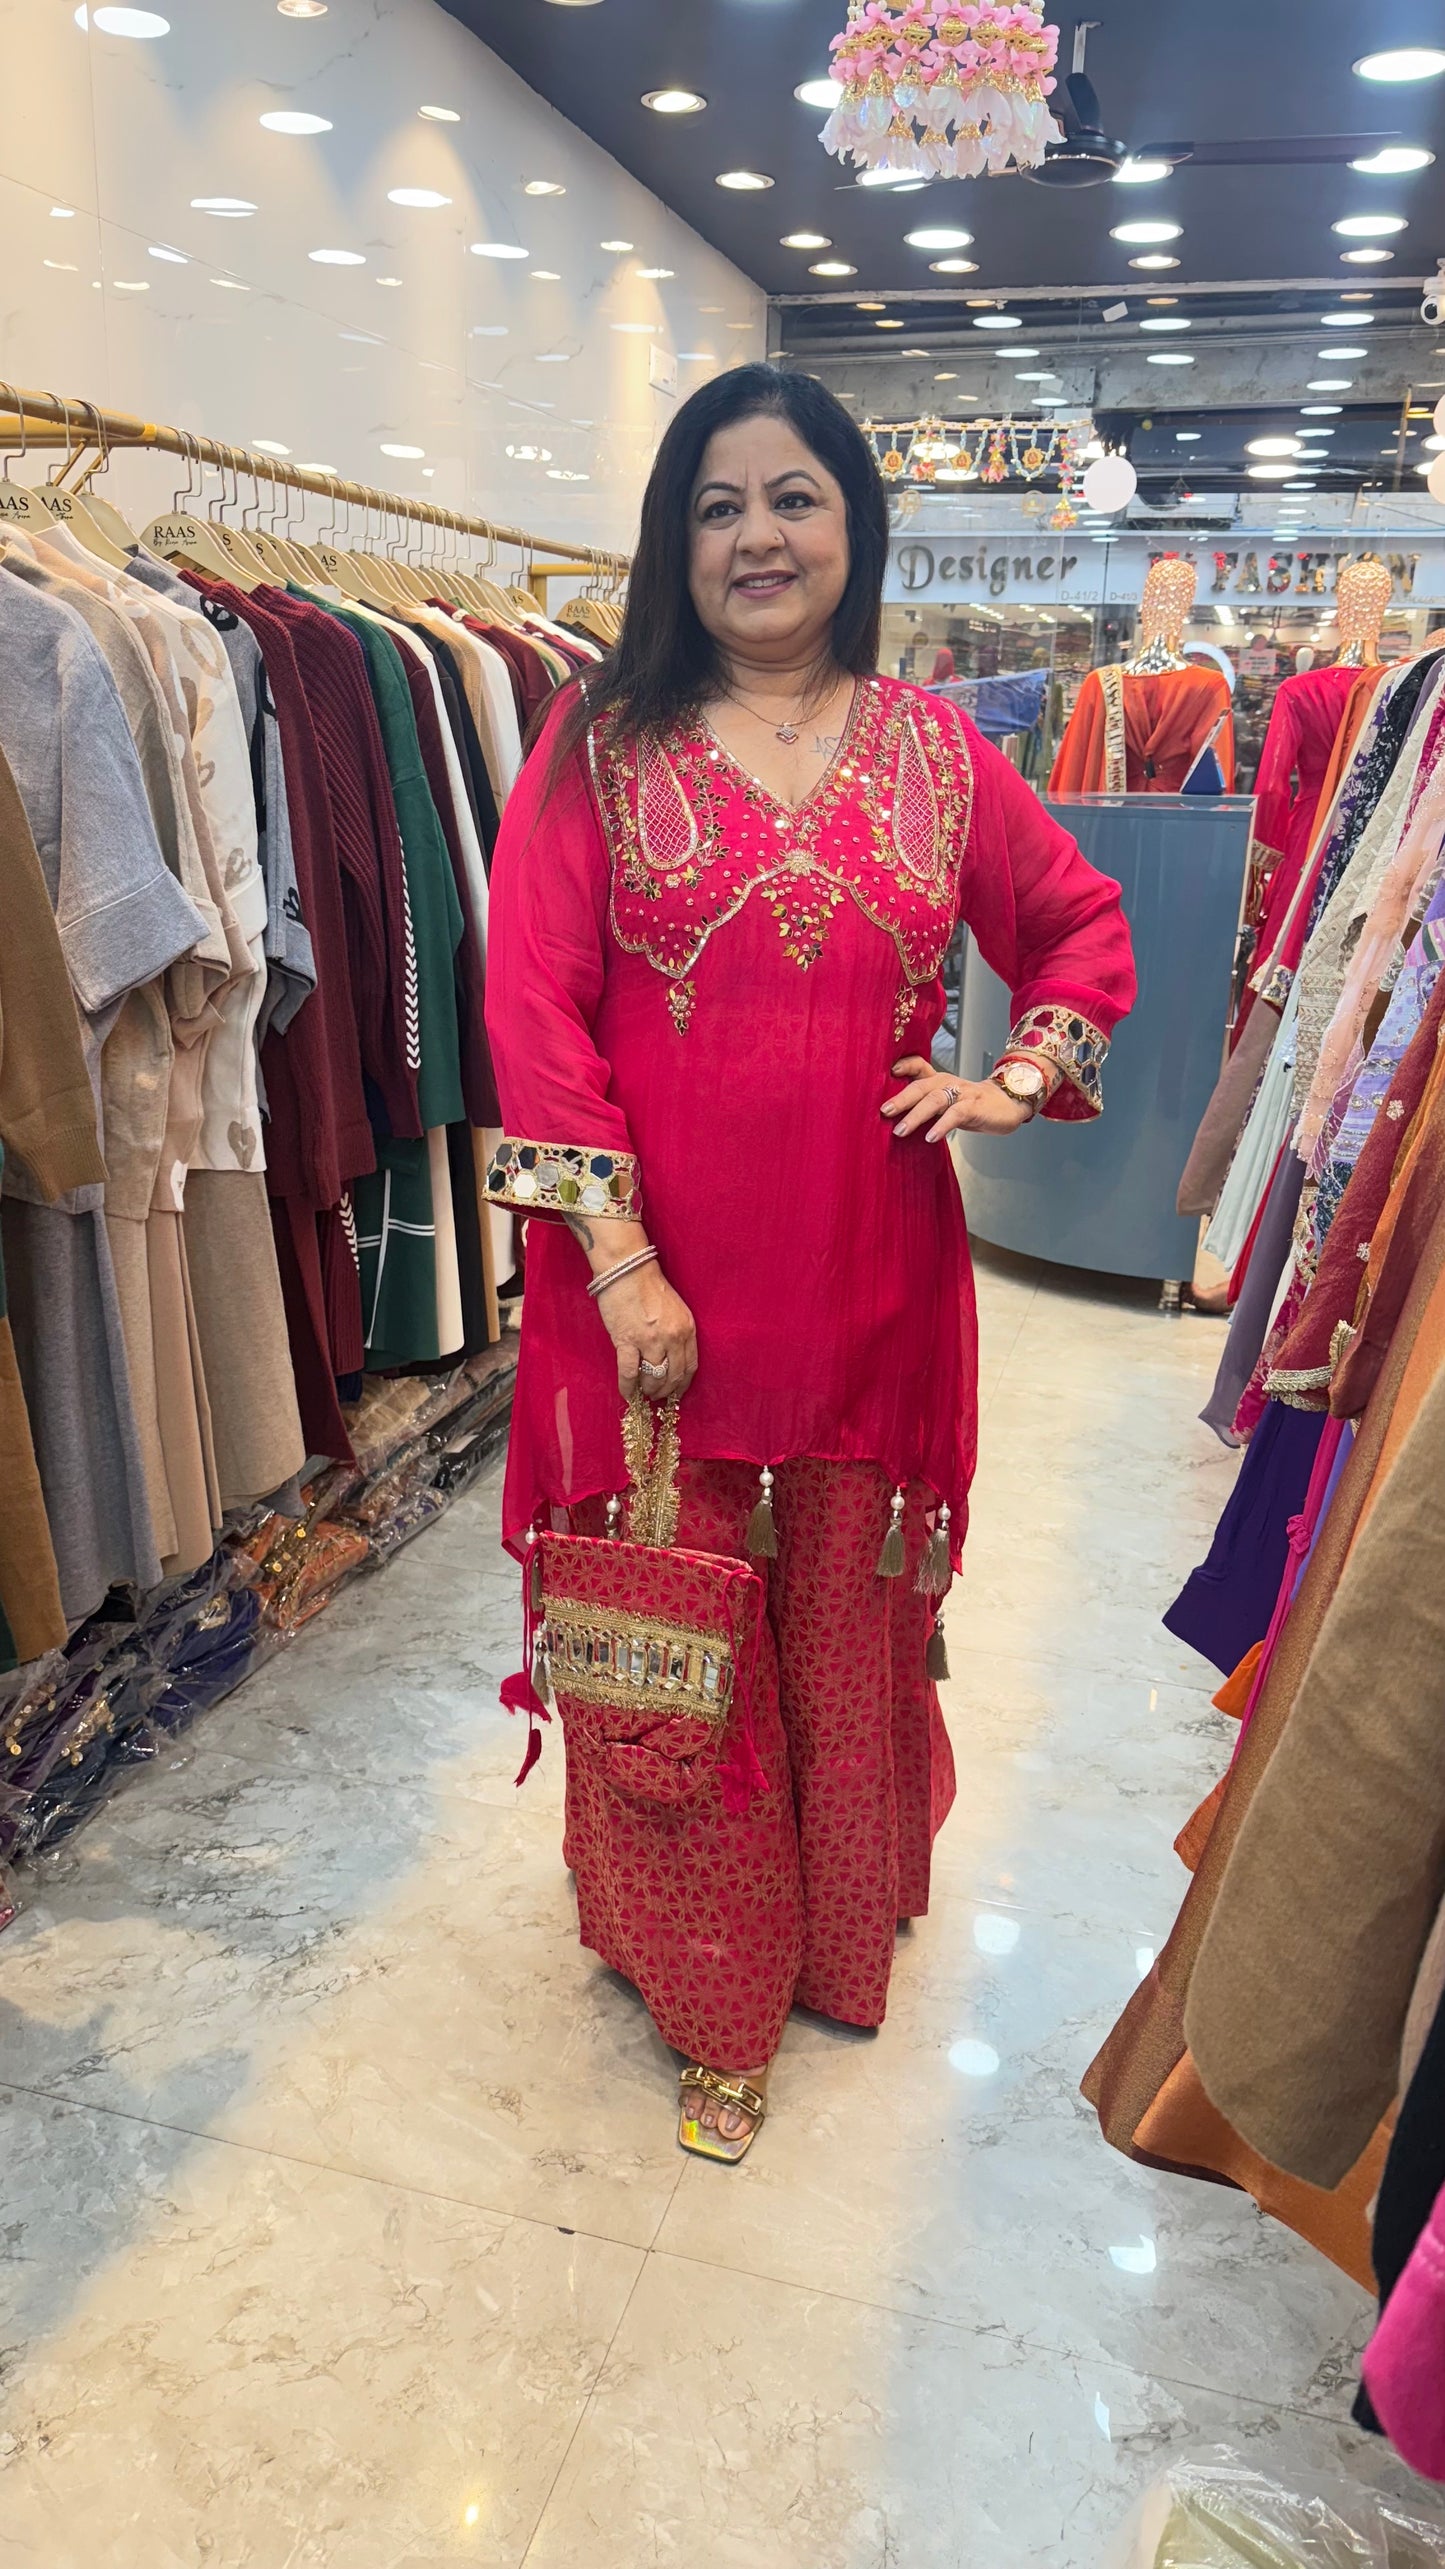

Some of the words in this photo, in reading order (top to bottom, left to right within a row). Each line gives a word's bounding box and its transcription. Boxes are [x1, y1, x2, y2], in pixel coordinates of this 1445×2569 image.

[154, 526, 196, 538] RAAS
[897, 545, 1077, 596] Designer
[1211, 553, 1421, 594] FASHIN
